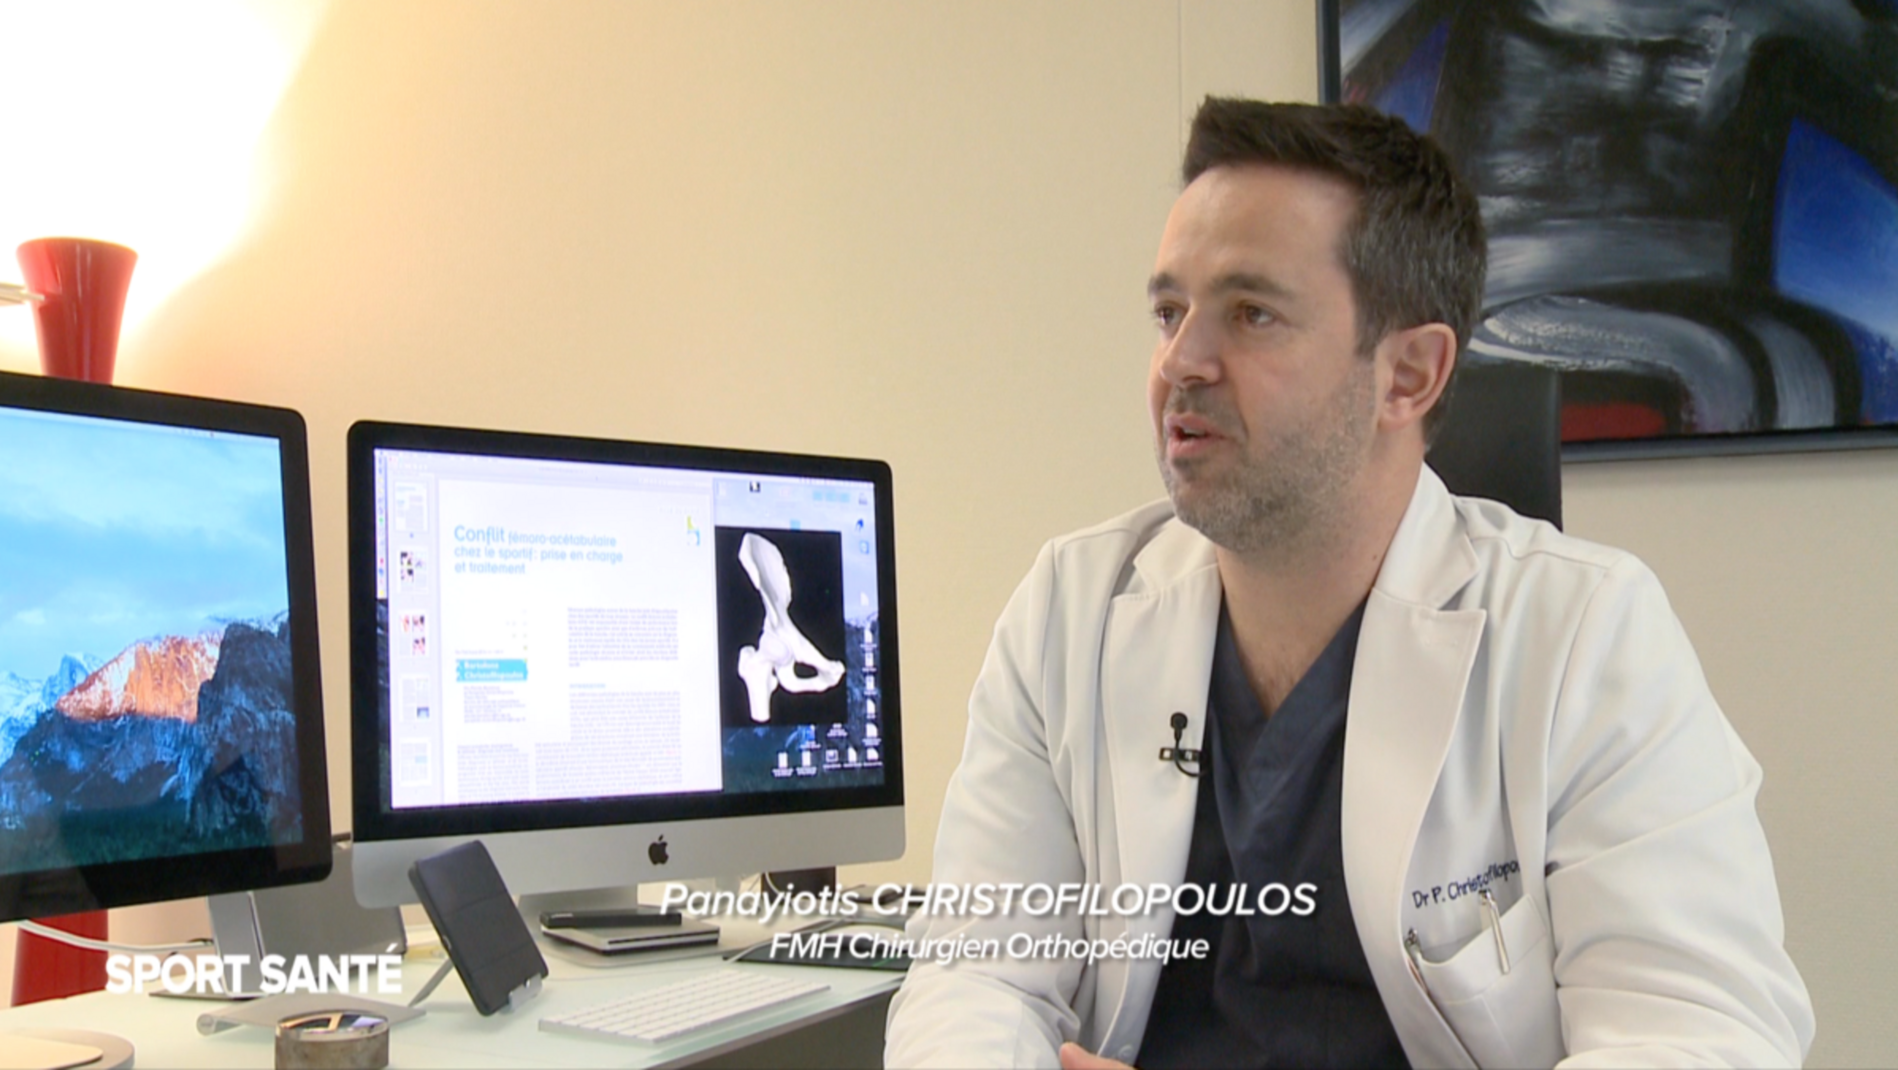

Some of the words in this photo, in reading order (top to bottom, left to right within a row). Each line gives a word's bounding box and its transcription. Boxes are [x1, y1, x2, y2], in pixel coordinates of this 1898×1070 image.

[454, 525, 505, 546] Conflit
[454, 546, 481, 558] chez
[485, 546, 495, 558] le
[540, 549, 567, 562] prise
[570, 551, 584, 560] en
[586, 550, 623, 565] charge
[454, 562, 466, 573] et
[469, 562, 526, 574] traitement
[1412, 890, 1429, 908] Dr
[1431, 885, 1446, 904] P.
[1447, 860, 1520, 900] Christofilopo
